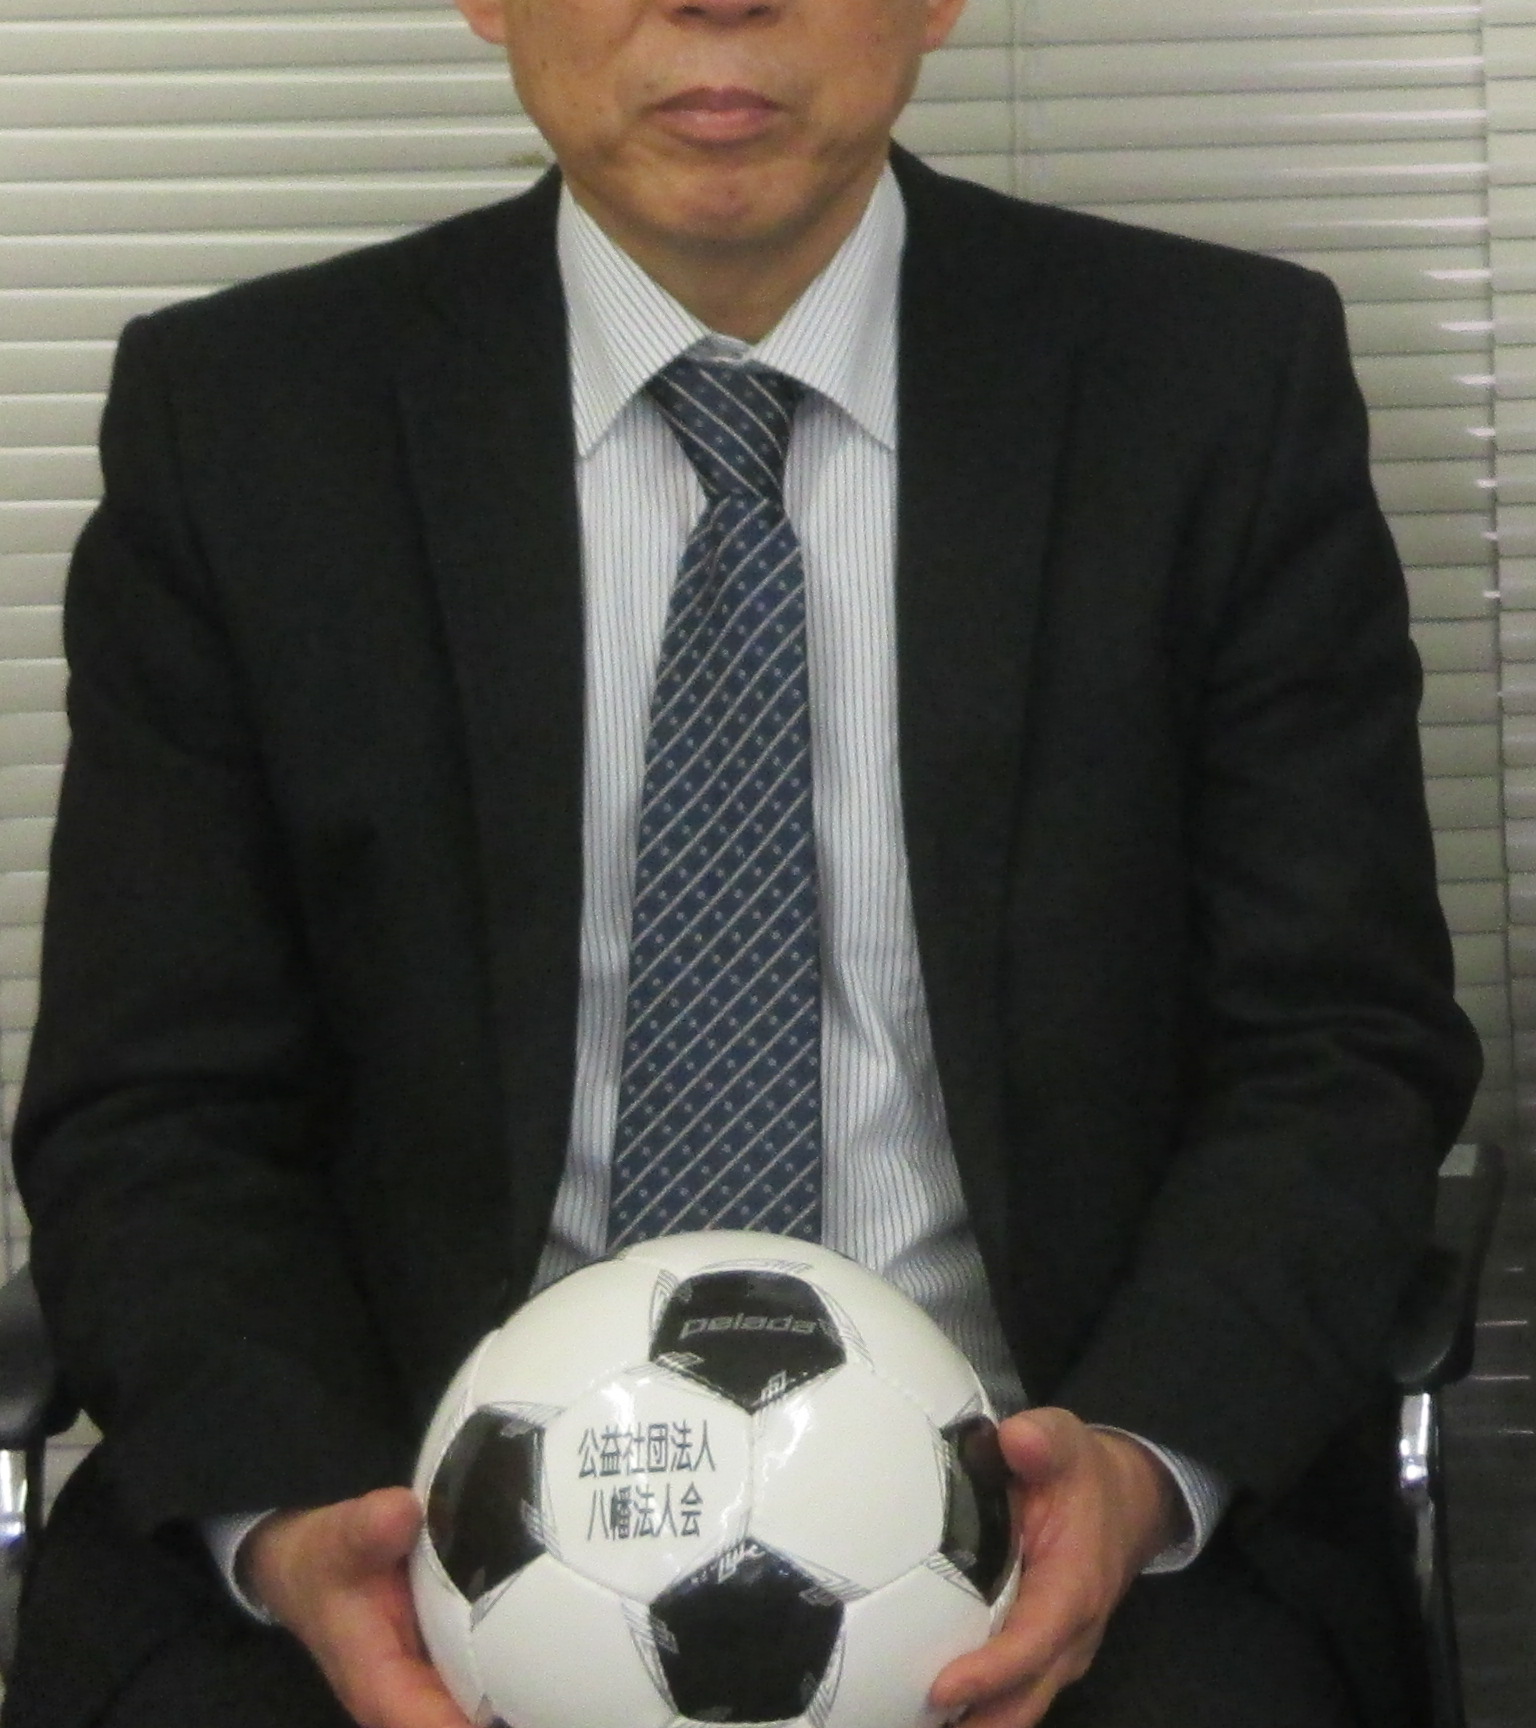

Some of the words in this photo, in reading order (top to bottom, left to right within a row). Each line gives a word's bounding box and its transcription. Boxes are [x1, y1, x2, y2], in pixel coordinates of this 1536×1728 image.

[577, 1419, 716, 1481] 公益社団法人
[587, 1482, 703, 1542] 八幡法人会
